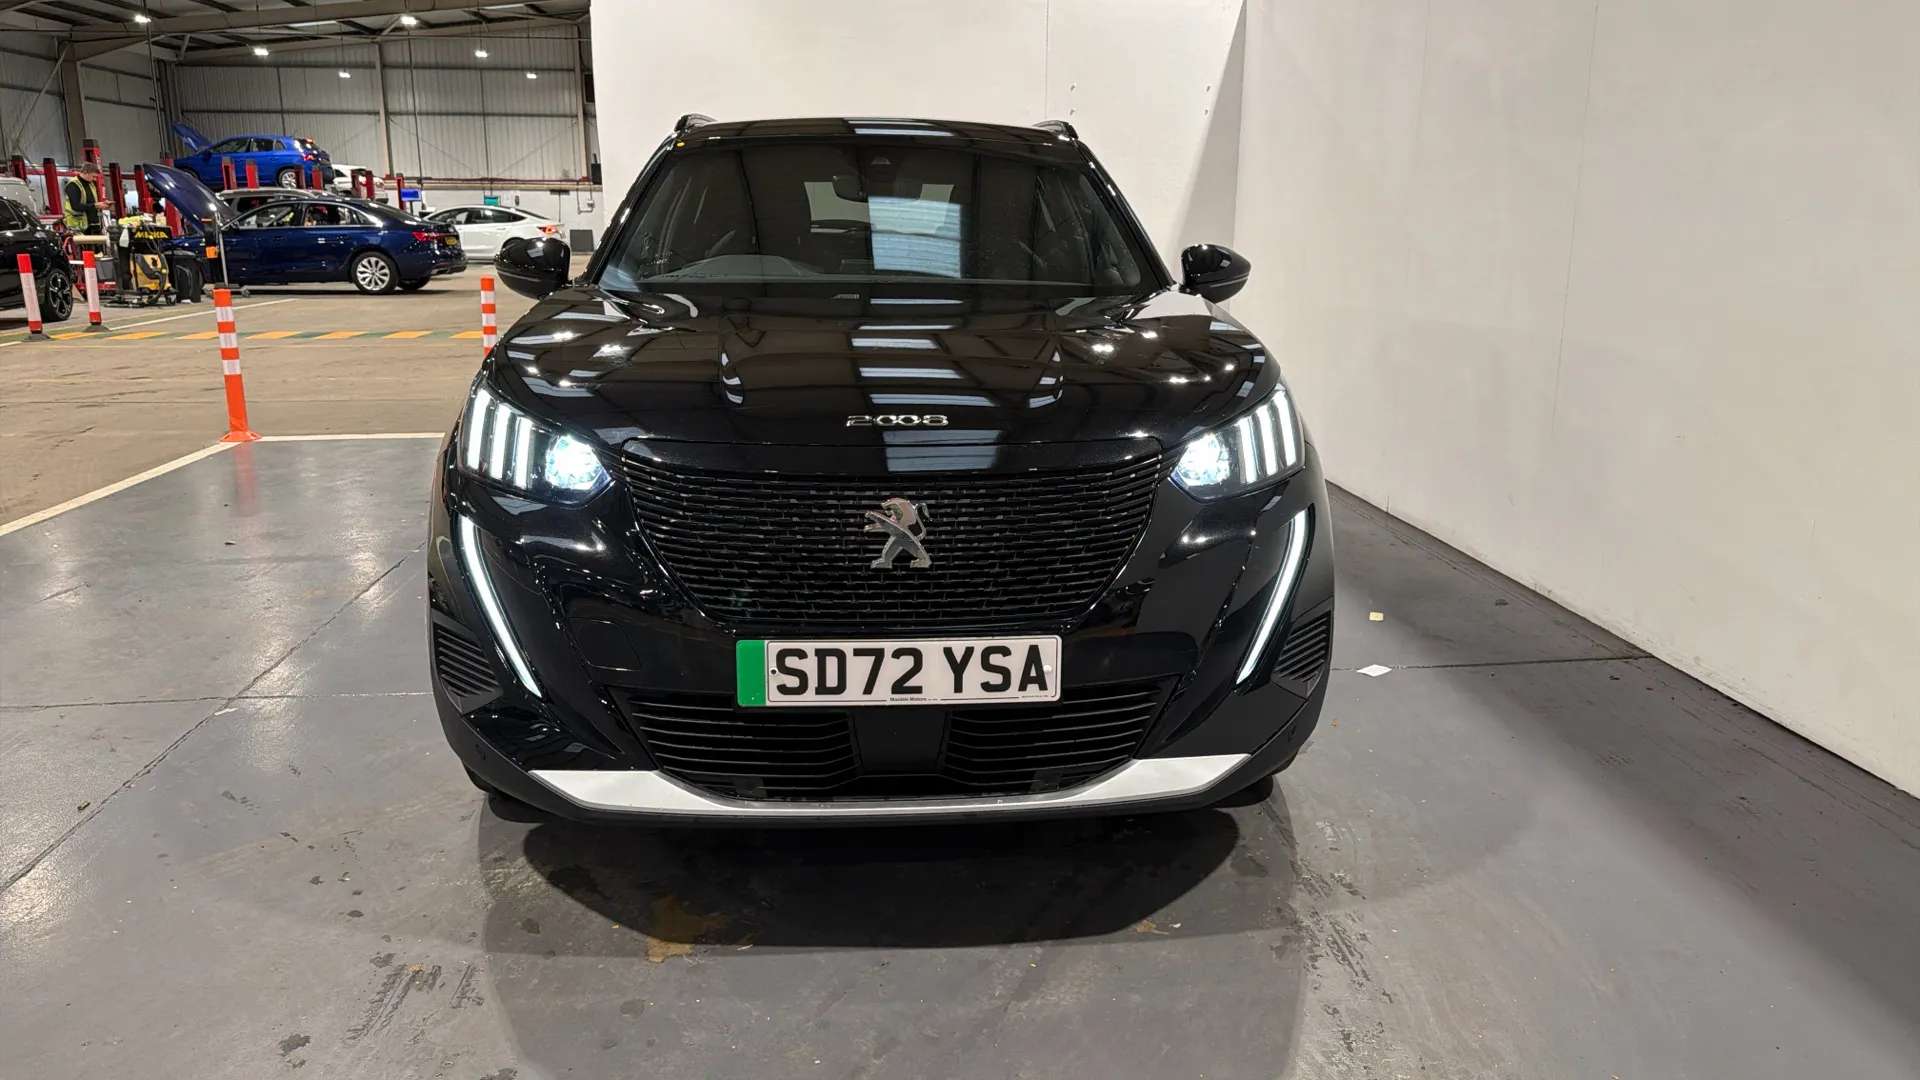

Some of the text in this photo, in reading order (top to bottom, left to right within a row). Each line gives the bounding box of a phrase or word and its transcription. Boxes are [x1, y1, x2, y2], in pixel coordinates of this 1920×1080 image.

[846, 415, 949, 427] 2008
[776, 644, 1048, 696] SD72 YSA
